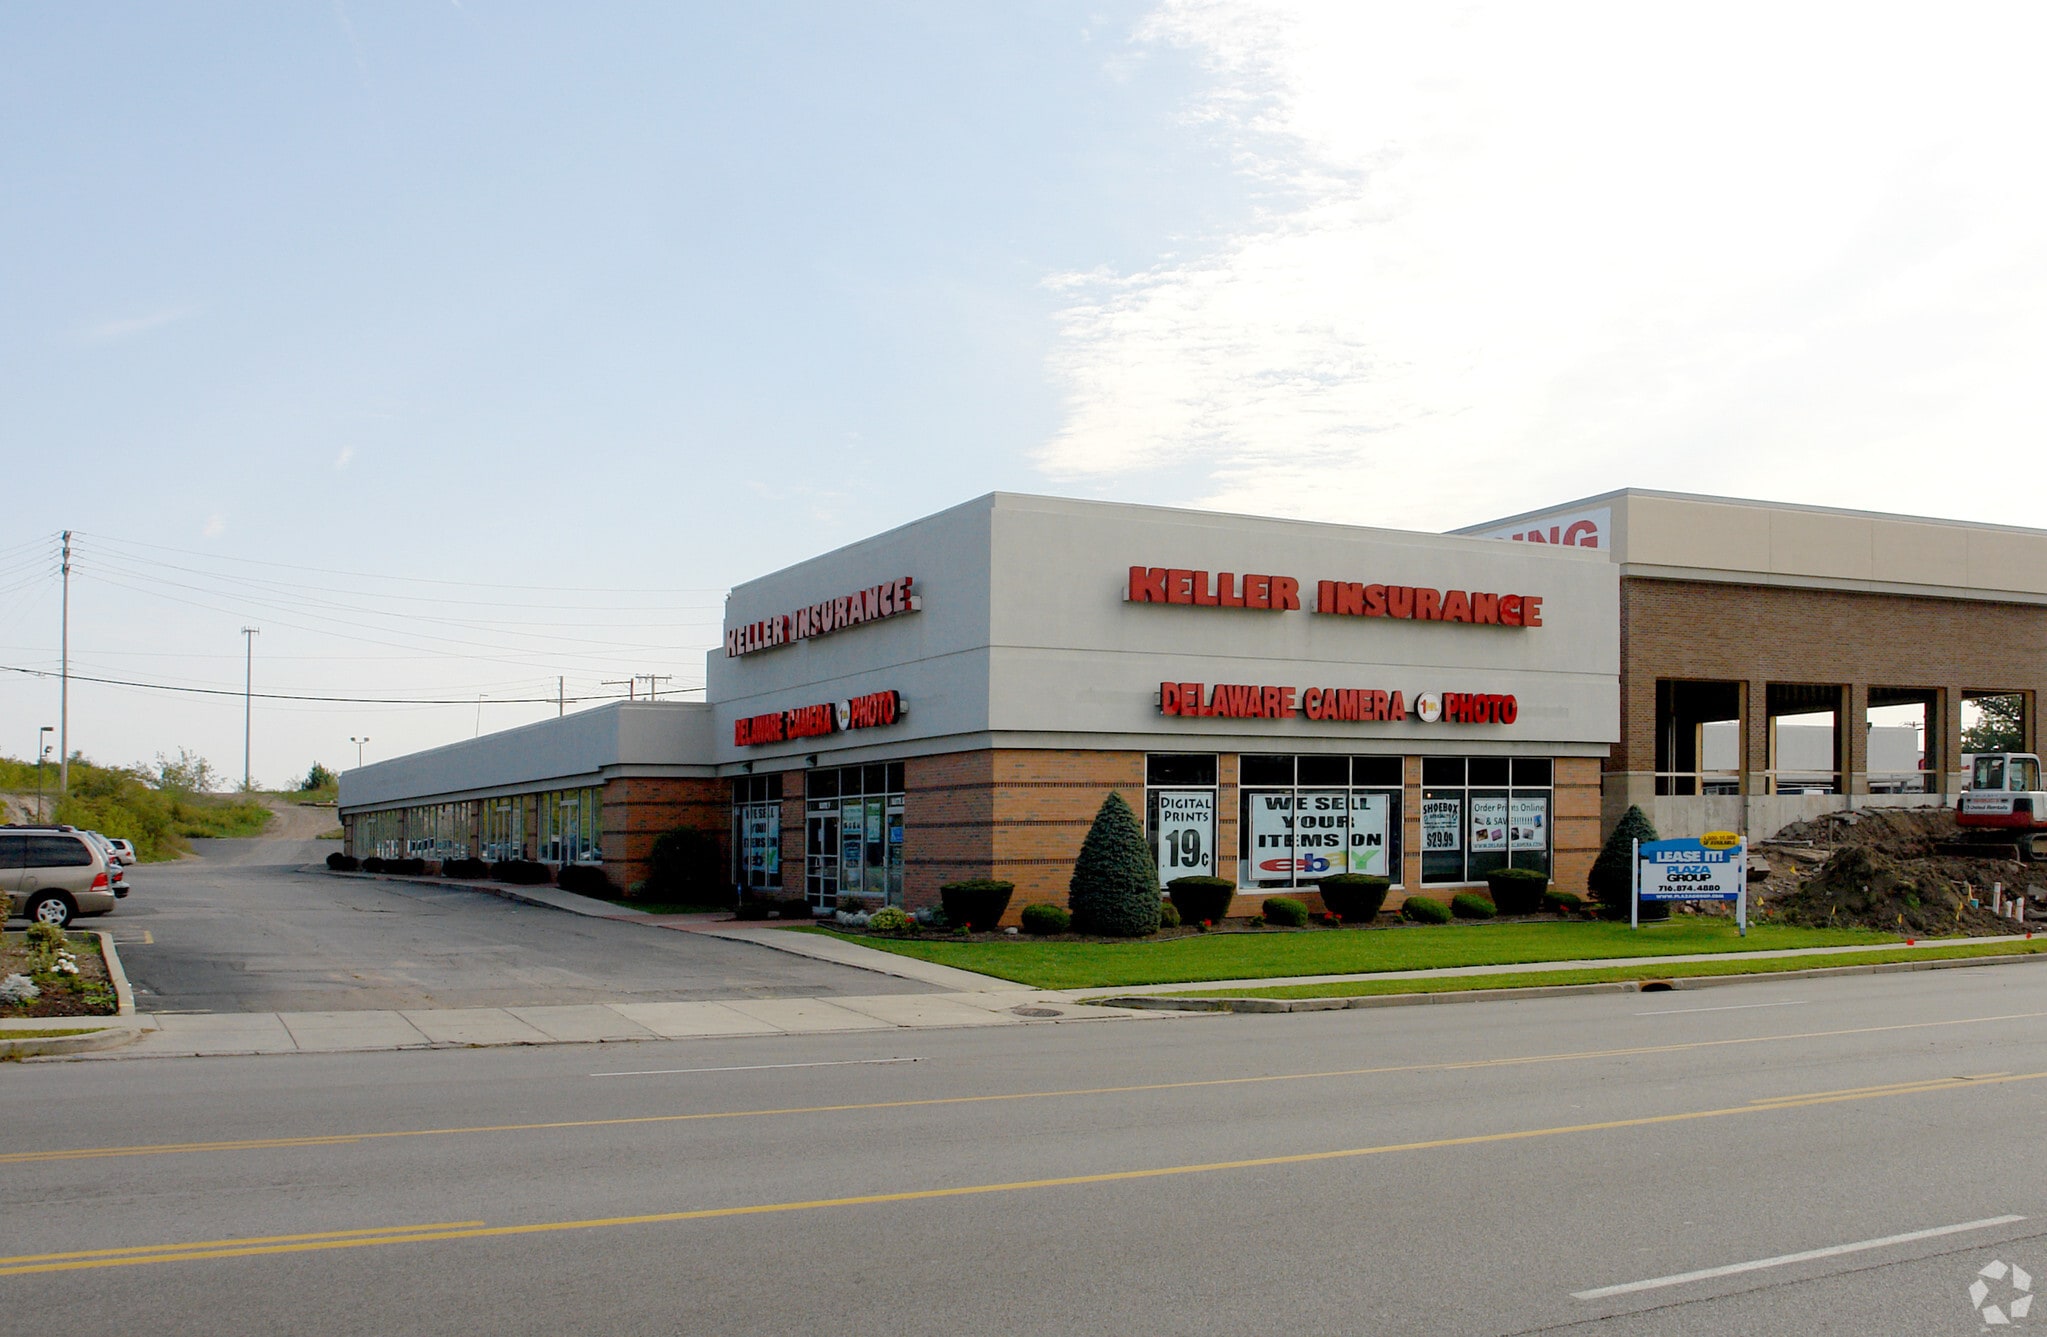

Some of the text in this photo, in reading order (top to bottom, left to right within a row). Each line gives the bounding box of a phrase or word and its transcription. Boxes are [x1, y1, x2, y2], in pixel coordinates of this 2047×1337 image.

[1129, 566, 1543, 627] KELLER INSURANCE
[725, 577, 912, 658] KELLER INSURANCE
[1160, 682, 1297, 719] DELAWARE
[1303, 687, 1406, 721] CAMERA
[1442, 692, 1518, 725] PHOTO
[734, 711, 787, 747] DELAWARE
[787, 702, 835, 740] CAMERA
[850, 690, 899, 730] PHOTO
[1161, 797, 1211, 809] DIGITAL
[1265, 797, 1308, 810] WE
[1423, 802, 1459, 815] SHOEBOX
[1474, 803, 1495, 812] Order
[1520, 803, 1545, 812] Online
[1164, 811, 1209, 822] PRINTS
[1281, 815, 1355, 828] YOUR
[1485, 816, 1492, 825] &
[1258, 833, 1382, 847] ITEMS ON
[1427, 831, 1454, 848] $29.99
[1656, 850, 1724, 863] LEASE IT!
[1666, 865, 1711, 874] PLAZA
[1666, 873, 1712, 882] GROUP
[1658, 884, 1721, 892] 716.874.4880
